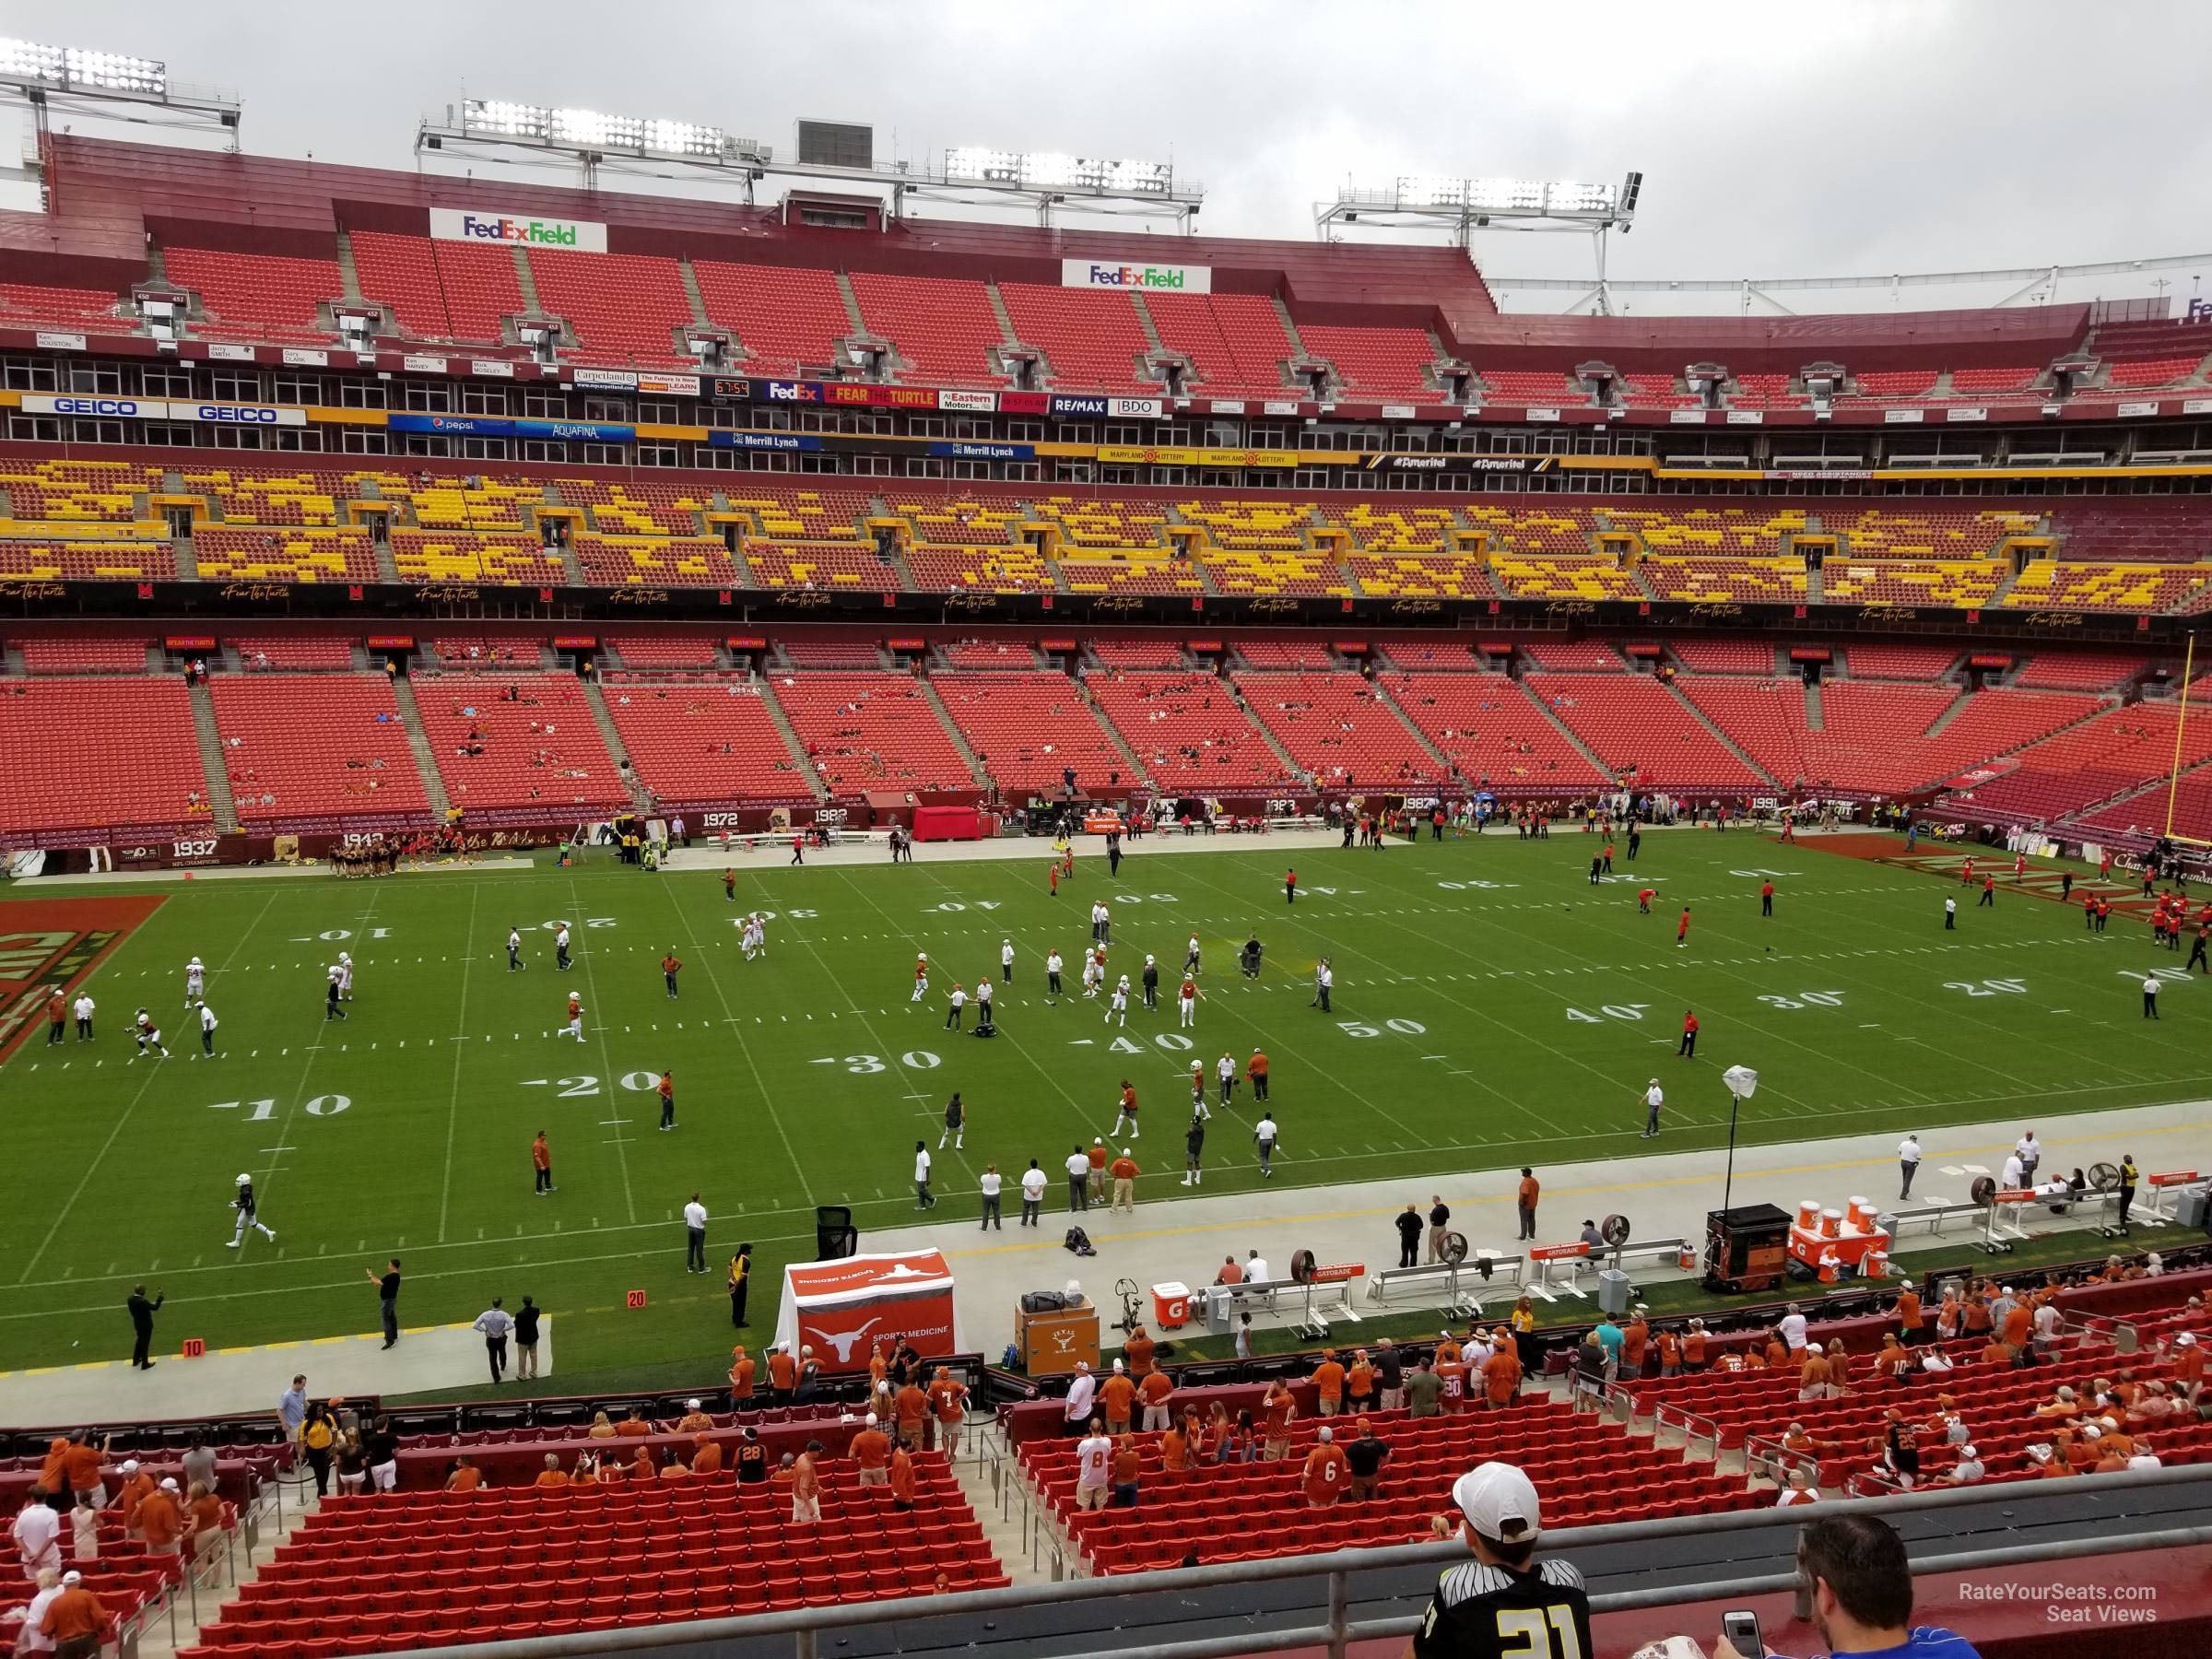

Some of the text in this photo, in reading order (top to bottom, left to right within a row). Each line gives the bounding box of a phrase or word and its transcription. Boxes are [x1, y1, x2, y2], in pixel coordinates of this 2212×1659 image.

[464, 216, 576, 245] FedExField
[1090, 265, 1183, 288] FedExField
[576, 370, 626, 382] Carpetland
[770, 383, 818, 401] FedEx
[951, 393, 991, 403] Eastern
[54, 398, 137, 416] GEICO
[198, 406, 276, 422] GEICO
[1055, 400, 1105, 413] RE/MAX
[1122, 400, 1151, 412] BDO
[446, 419, 474, 430] pepsi
[552, 425, 598, 439] AQUAFINA
[745, 436, 798, 448] Merrill Lynch
[963, 445, 1014, 458] Merrill Lynch
[1110, 451, 1143, 459] MARYLAND
[1210, 453, 1244, 462] MARYLAND
[1752, 797, 1778, 809] 1991
[703, 812, 738, 827] 1972
[173, 840, 217, 857] 1937
[1943, 980, 2027, 996] 20
[1757, 992, 1842, 1008] 30
[1567, 1005, 1642, 1022] 40
[1335, 1018, 1426, 1037] 50
[1109, 1034, 1193, 1053] 40
[844, 1052, 940, 1073] 30
[557, 1071, 662, 1097] 20
[241, 1095, 351, 1121] 10
[1547, 1247, 1579, 1256] GATORADE
[1797, 1242, 1806, 1255] G
[1317, 1267, 1352, 1277] GATORADE
[629, 1291, 644, 1307] 20
[1169, 1301, 1182, 1318] G
[873, 1325, 948, 1343] SPORTS MEDICINE
[1053, 1328, 1076, 1338] TEXAS
[185, 1340, 201, 1356] 10
[1669, 1337, 1676, 1350] 1
[1893, 1359, 1907, 1374] 10
[1445, 1380, 1460, 1396] 20
[941, 1391, 952, 1407] 7
[1898, 1433, 1915, 1450] 25
[743, 1445, 760, 1461] 28
[1324, 1461, 1335, 1481] 6
[1497, 1604, 1581, 1659] 21
